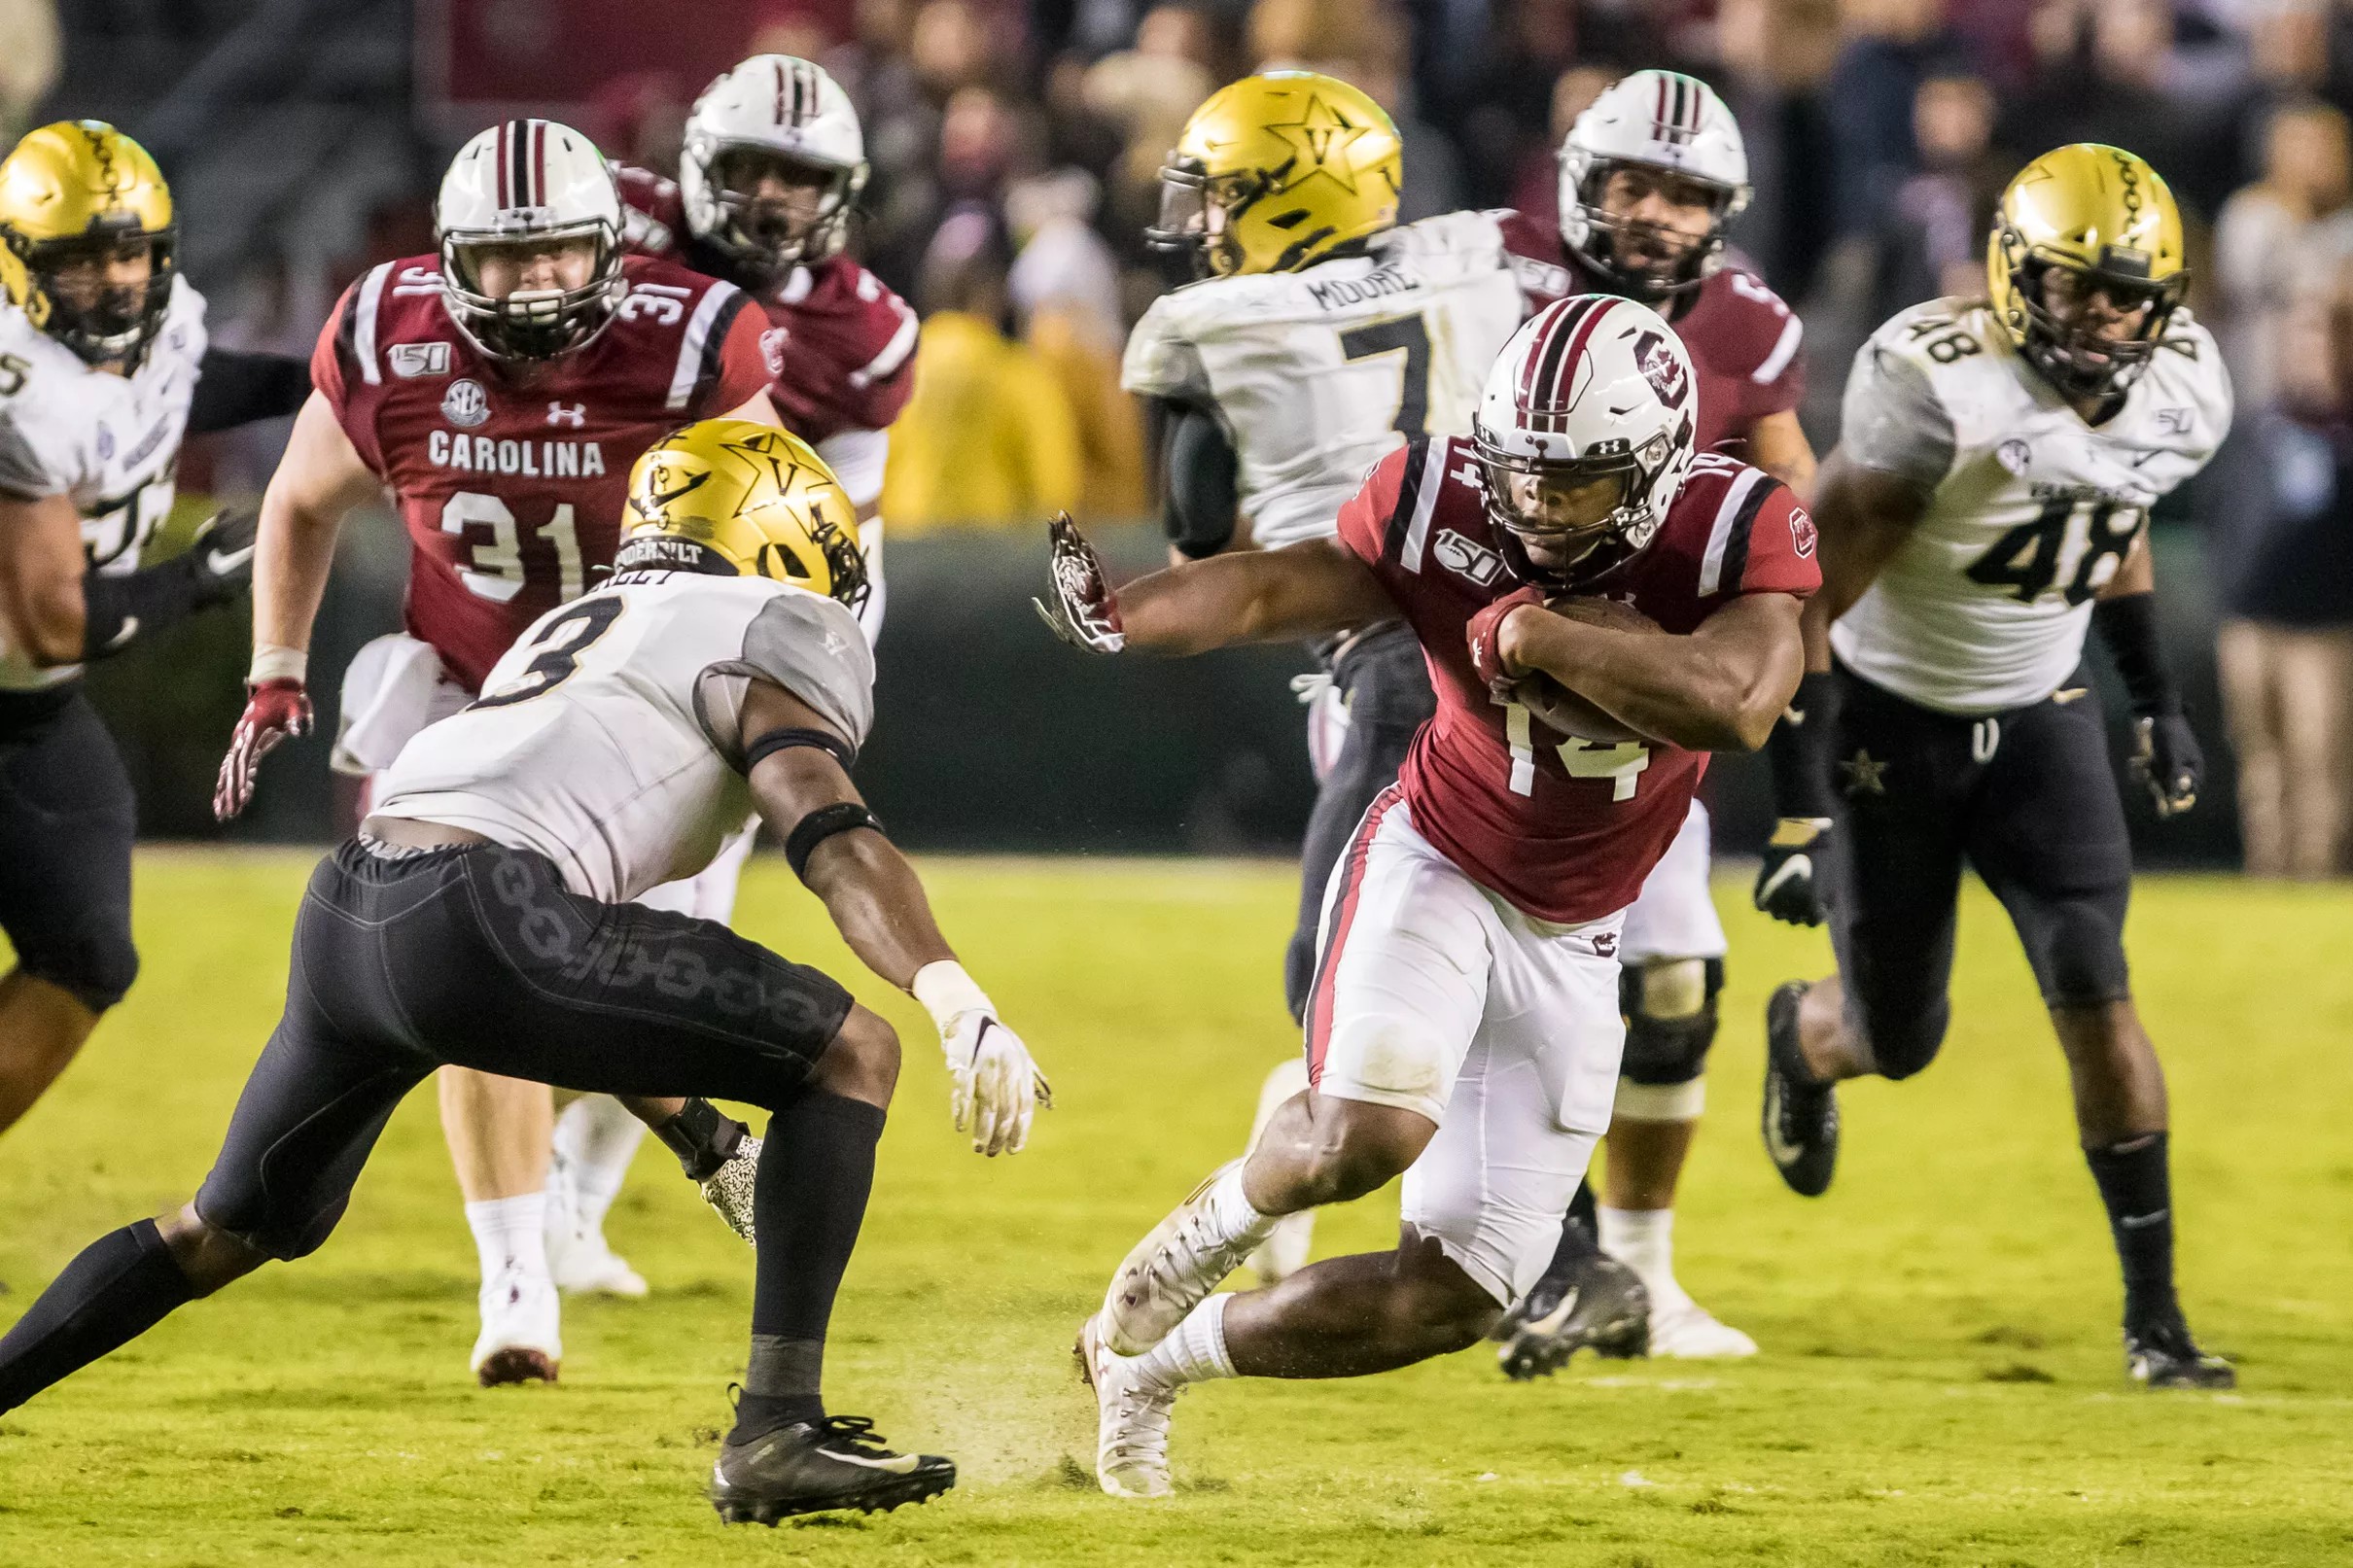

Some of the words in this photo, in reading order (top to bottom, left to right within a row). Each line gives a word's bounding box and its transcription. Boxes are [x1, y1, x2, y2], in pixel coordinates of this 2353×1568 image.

[619, 283, 692, 326] 31
[1908, 319, 1983, 364] 48
[1338, 309, 1434, 440] 7
[429, 430, 605, 477] CAROLINA
[766, 456, 798, 496] V
[441, 491, 584, 604] 31
[1965, 498, 2144, 608] 48
[466, 594, 627, 713] 3
